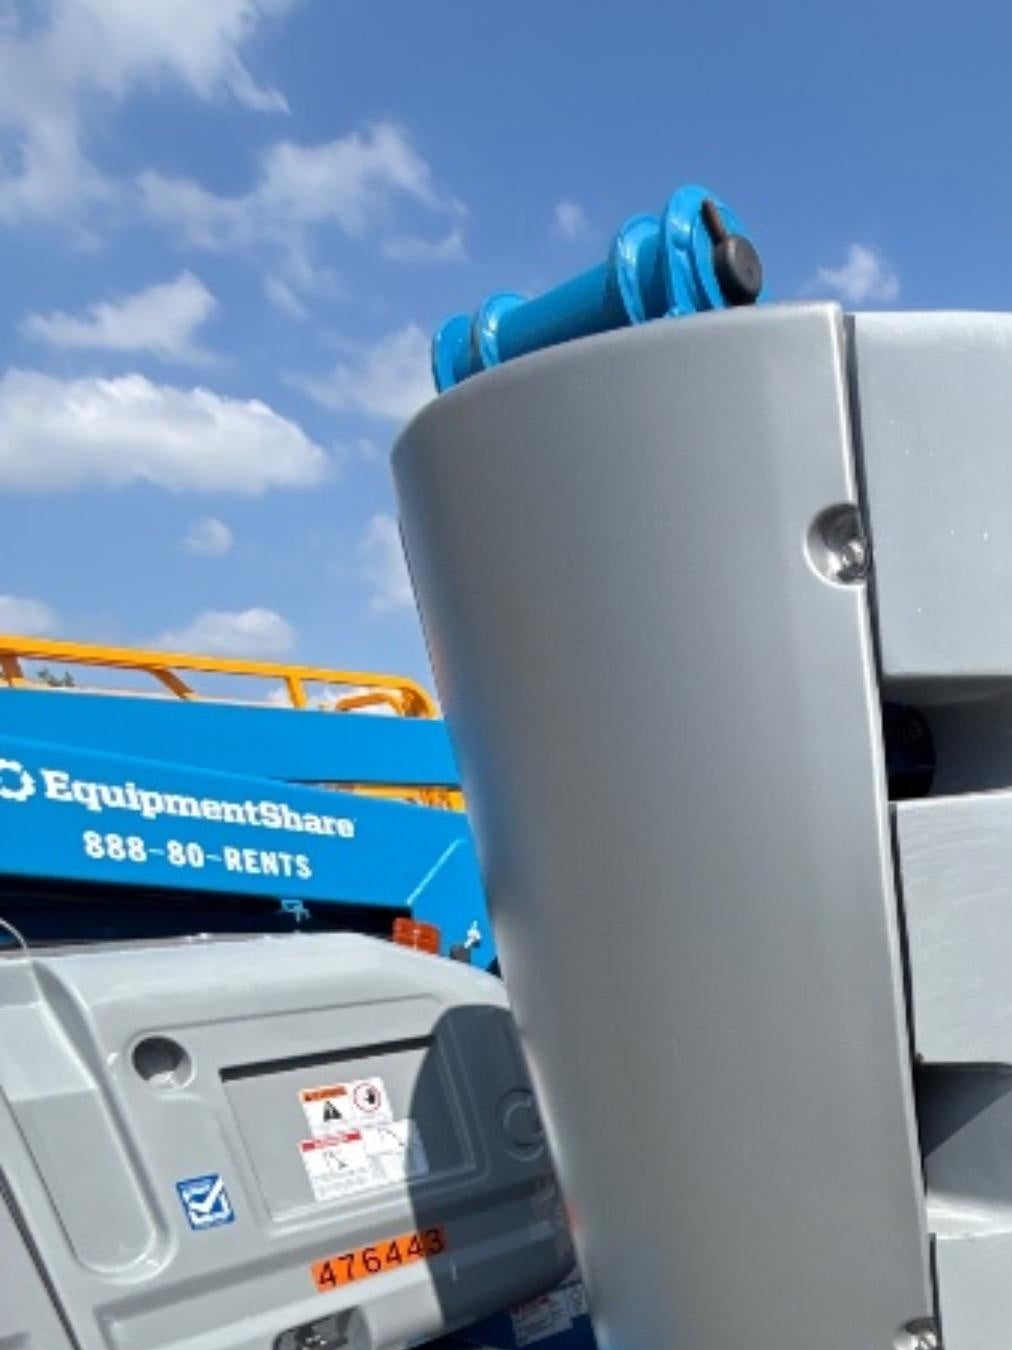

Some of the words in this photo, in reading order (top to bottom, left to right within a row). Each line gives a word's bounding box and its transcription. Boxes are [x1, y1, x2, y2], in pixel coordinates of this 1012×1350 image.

[40, 768, 356, 838] EquipmentShare
[83, 830, 312, 879] 888-80-RENTS
[318, 1229, 444, 1289] 476443
